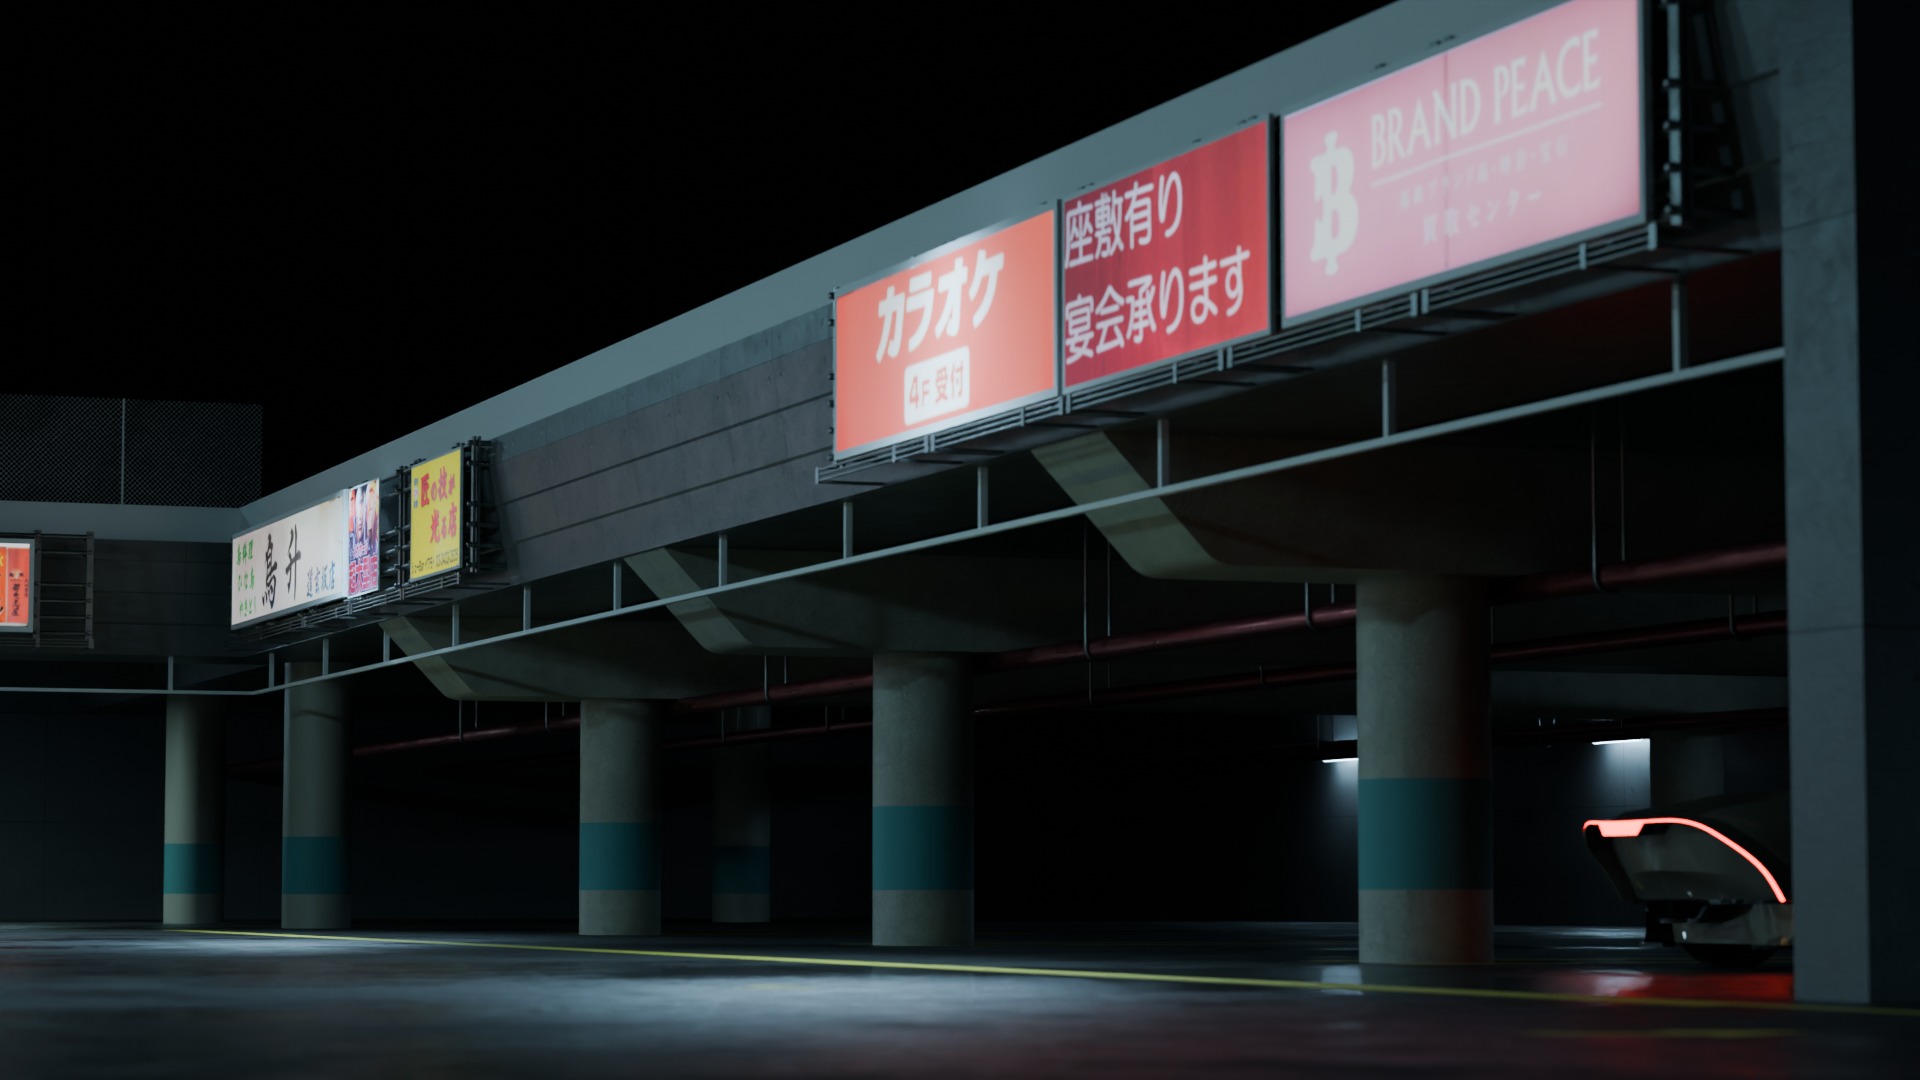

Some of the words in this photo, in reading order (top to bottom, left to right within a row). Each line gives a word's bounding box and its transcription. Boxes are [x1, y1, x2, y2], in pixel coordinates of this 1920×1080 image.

[1371, 77, 1482, 169] BRAND
[1493, 27, 1602, 124] PEACE
[1064, 170, 1184, 270] 座敷有り
[875, 248, 1005, 364] カラオケ
[1065, 245, 1251, 366] 宴会承ります
[421, 466, 455, 507] 匠の技が
[430, 502, 457, 543] 光る店
